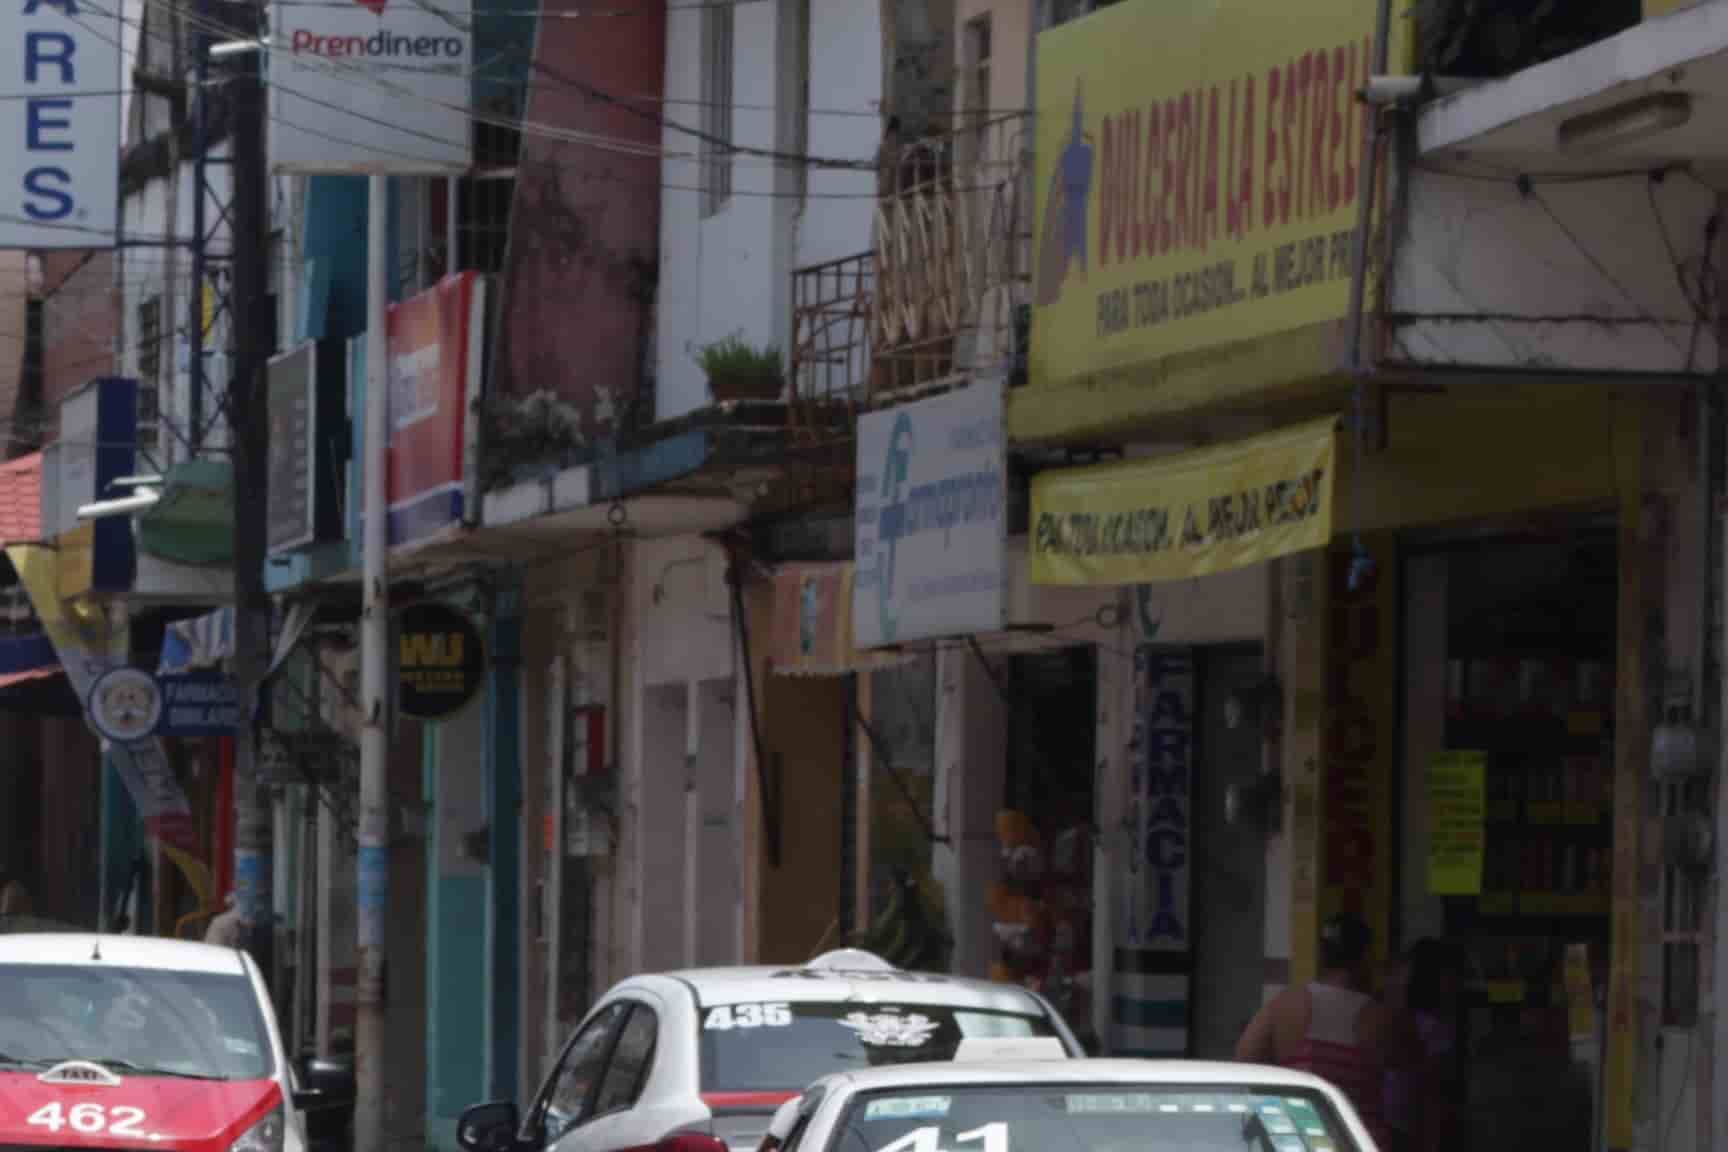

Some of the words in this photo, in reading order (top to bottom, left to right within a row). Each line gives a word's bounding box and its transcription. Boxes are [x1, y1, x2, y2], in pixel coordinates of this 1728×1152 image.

[292, 29, 463, 57] Prendinero
[1226, 71, 1255, 241] LA
[1263, 40, 1370, 226] ESTREL
[1146, 650, 1189, 942] FARMACIA
[704, 1003, 793, 1030] 435
[27, 1101, 147, 1138] 462
